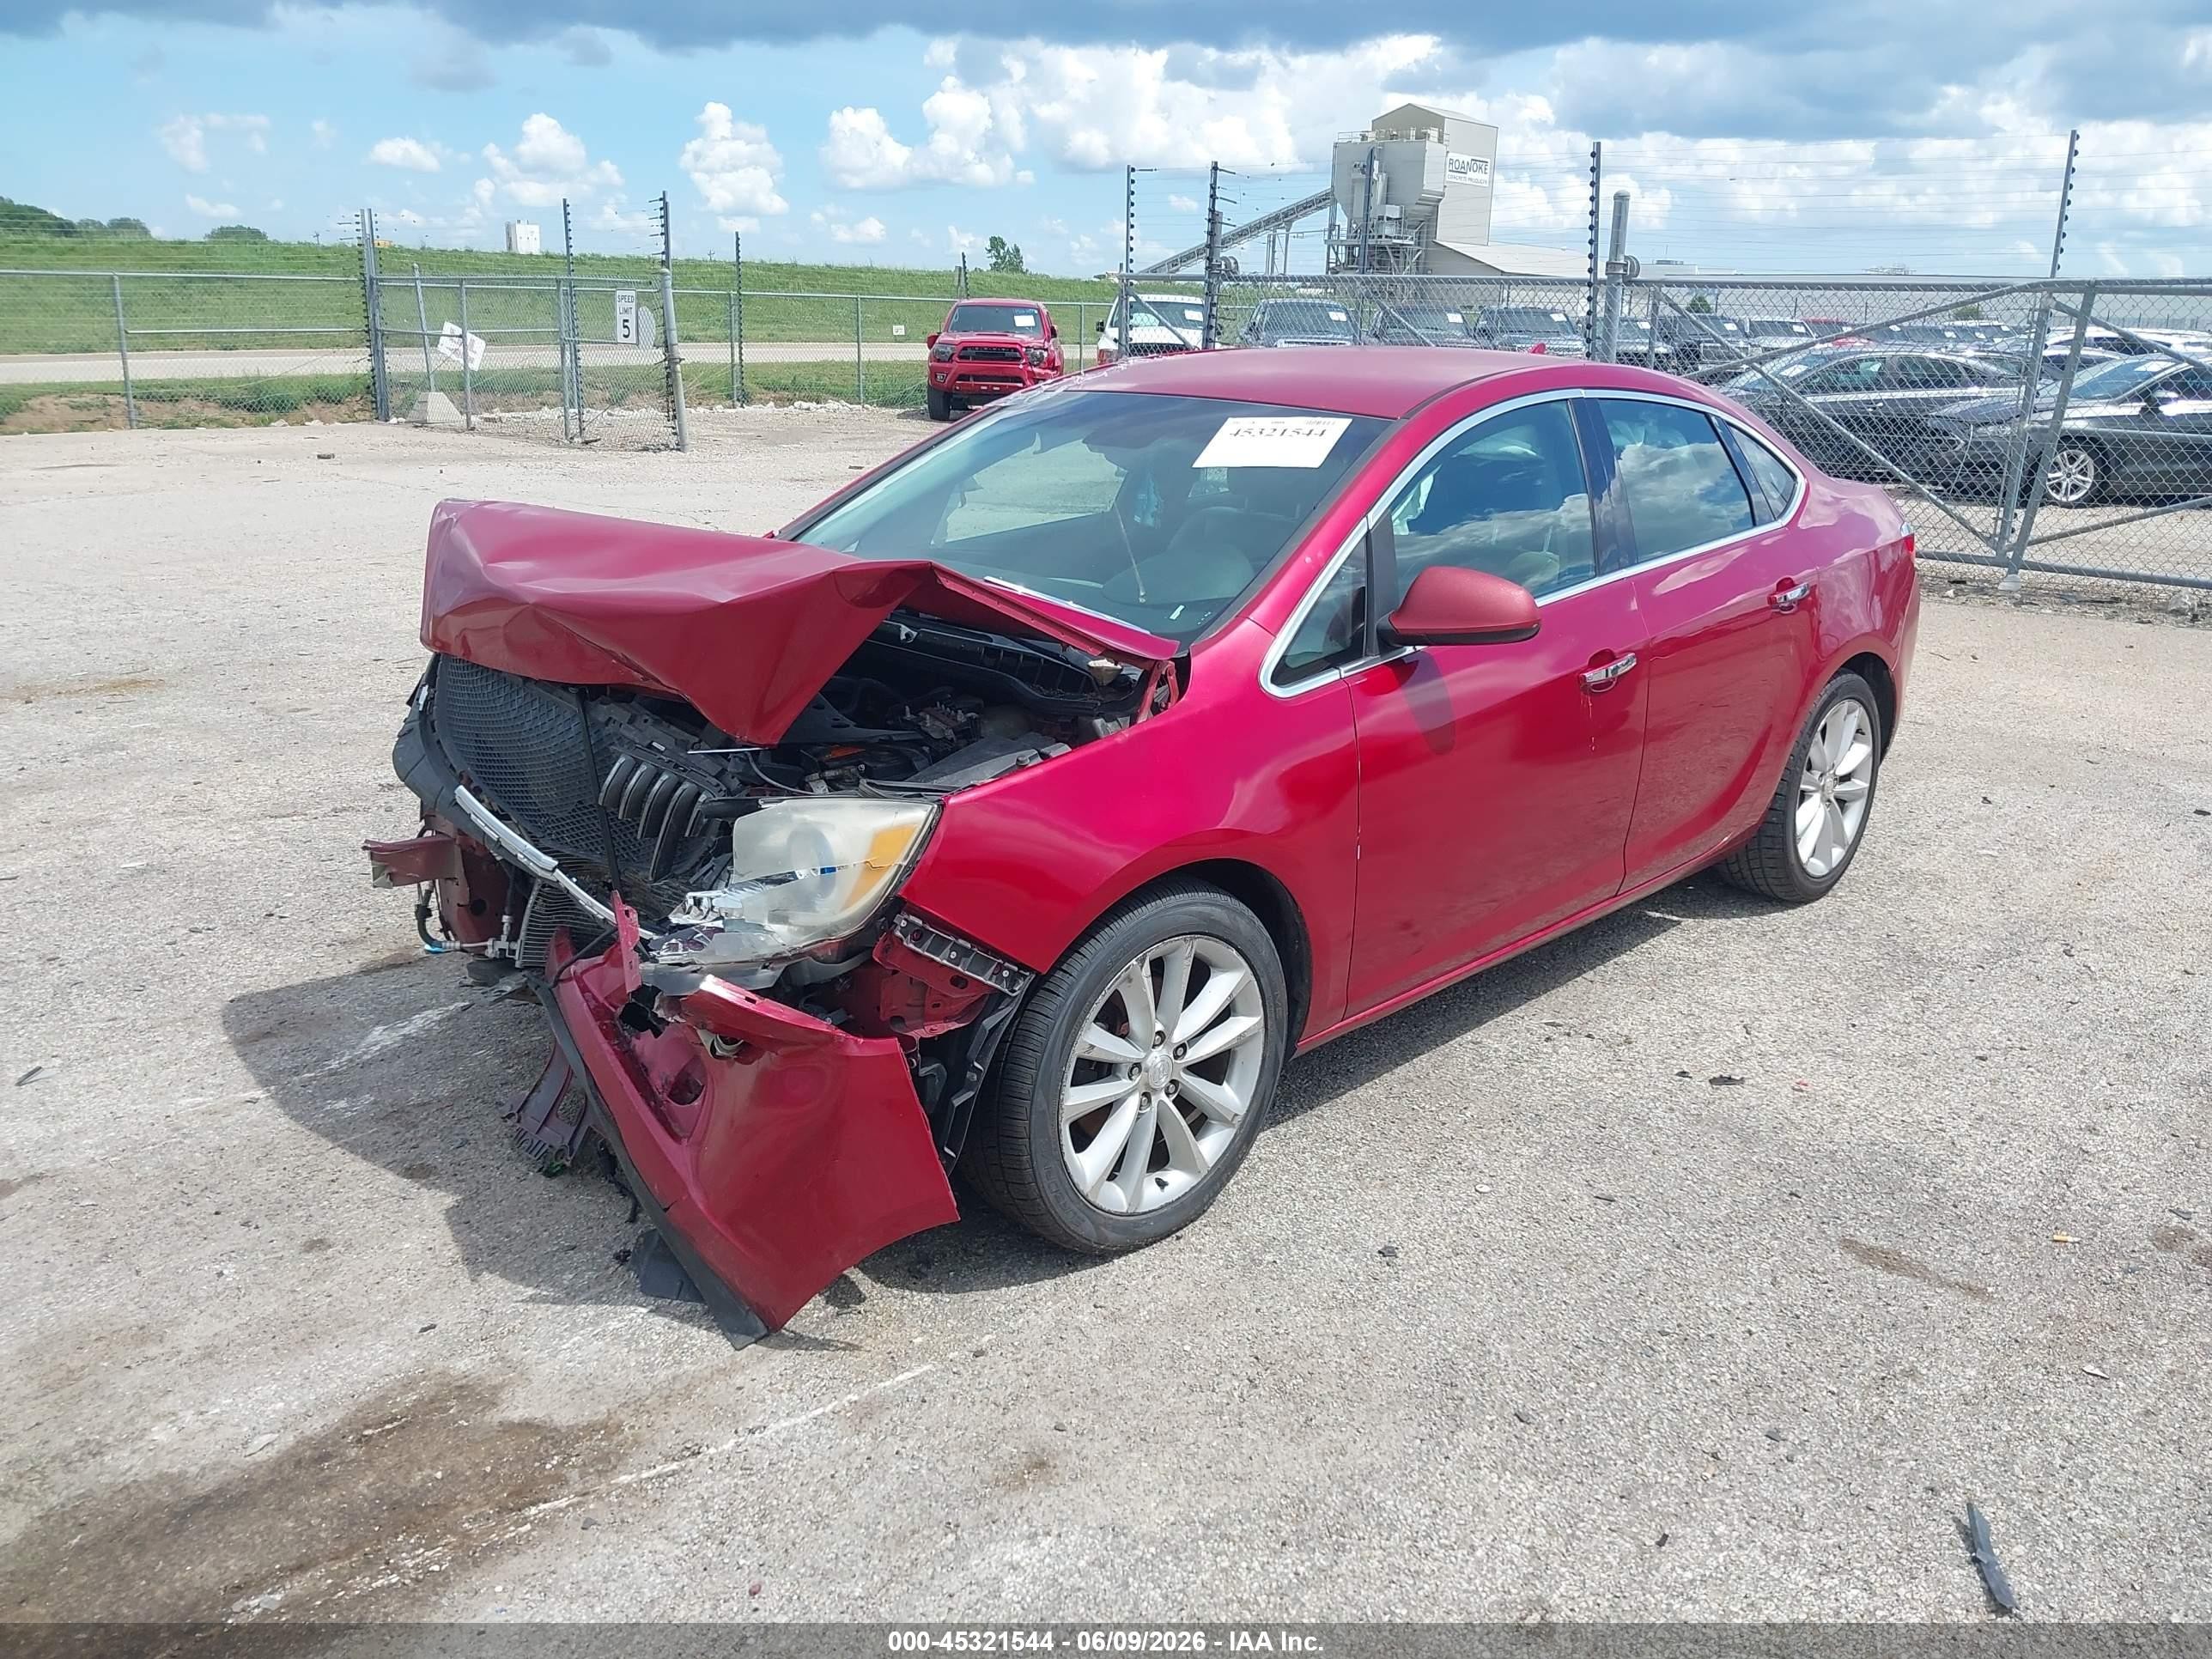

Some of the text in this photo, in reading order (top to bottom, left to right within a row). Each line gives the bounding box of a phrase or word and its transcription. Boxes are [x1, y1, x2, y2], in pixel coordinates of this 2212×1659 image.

[1449, 158, 1488, 174] ROANOKE
[617, 295, 634, 303] SPEED
[618, 306, 633, 315] LIMIT
[623, 319, 630, 338] 5
[1229, 428, 1327, 438] 45321544
